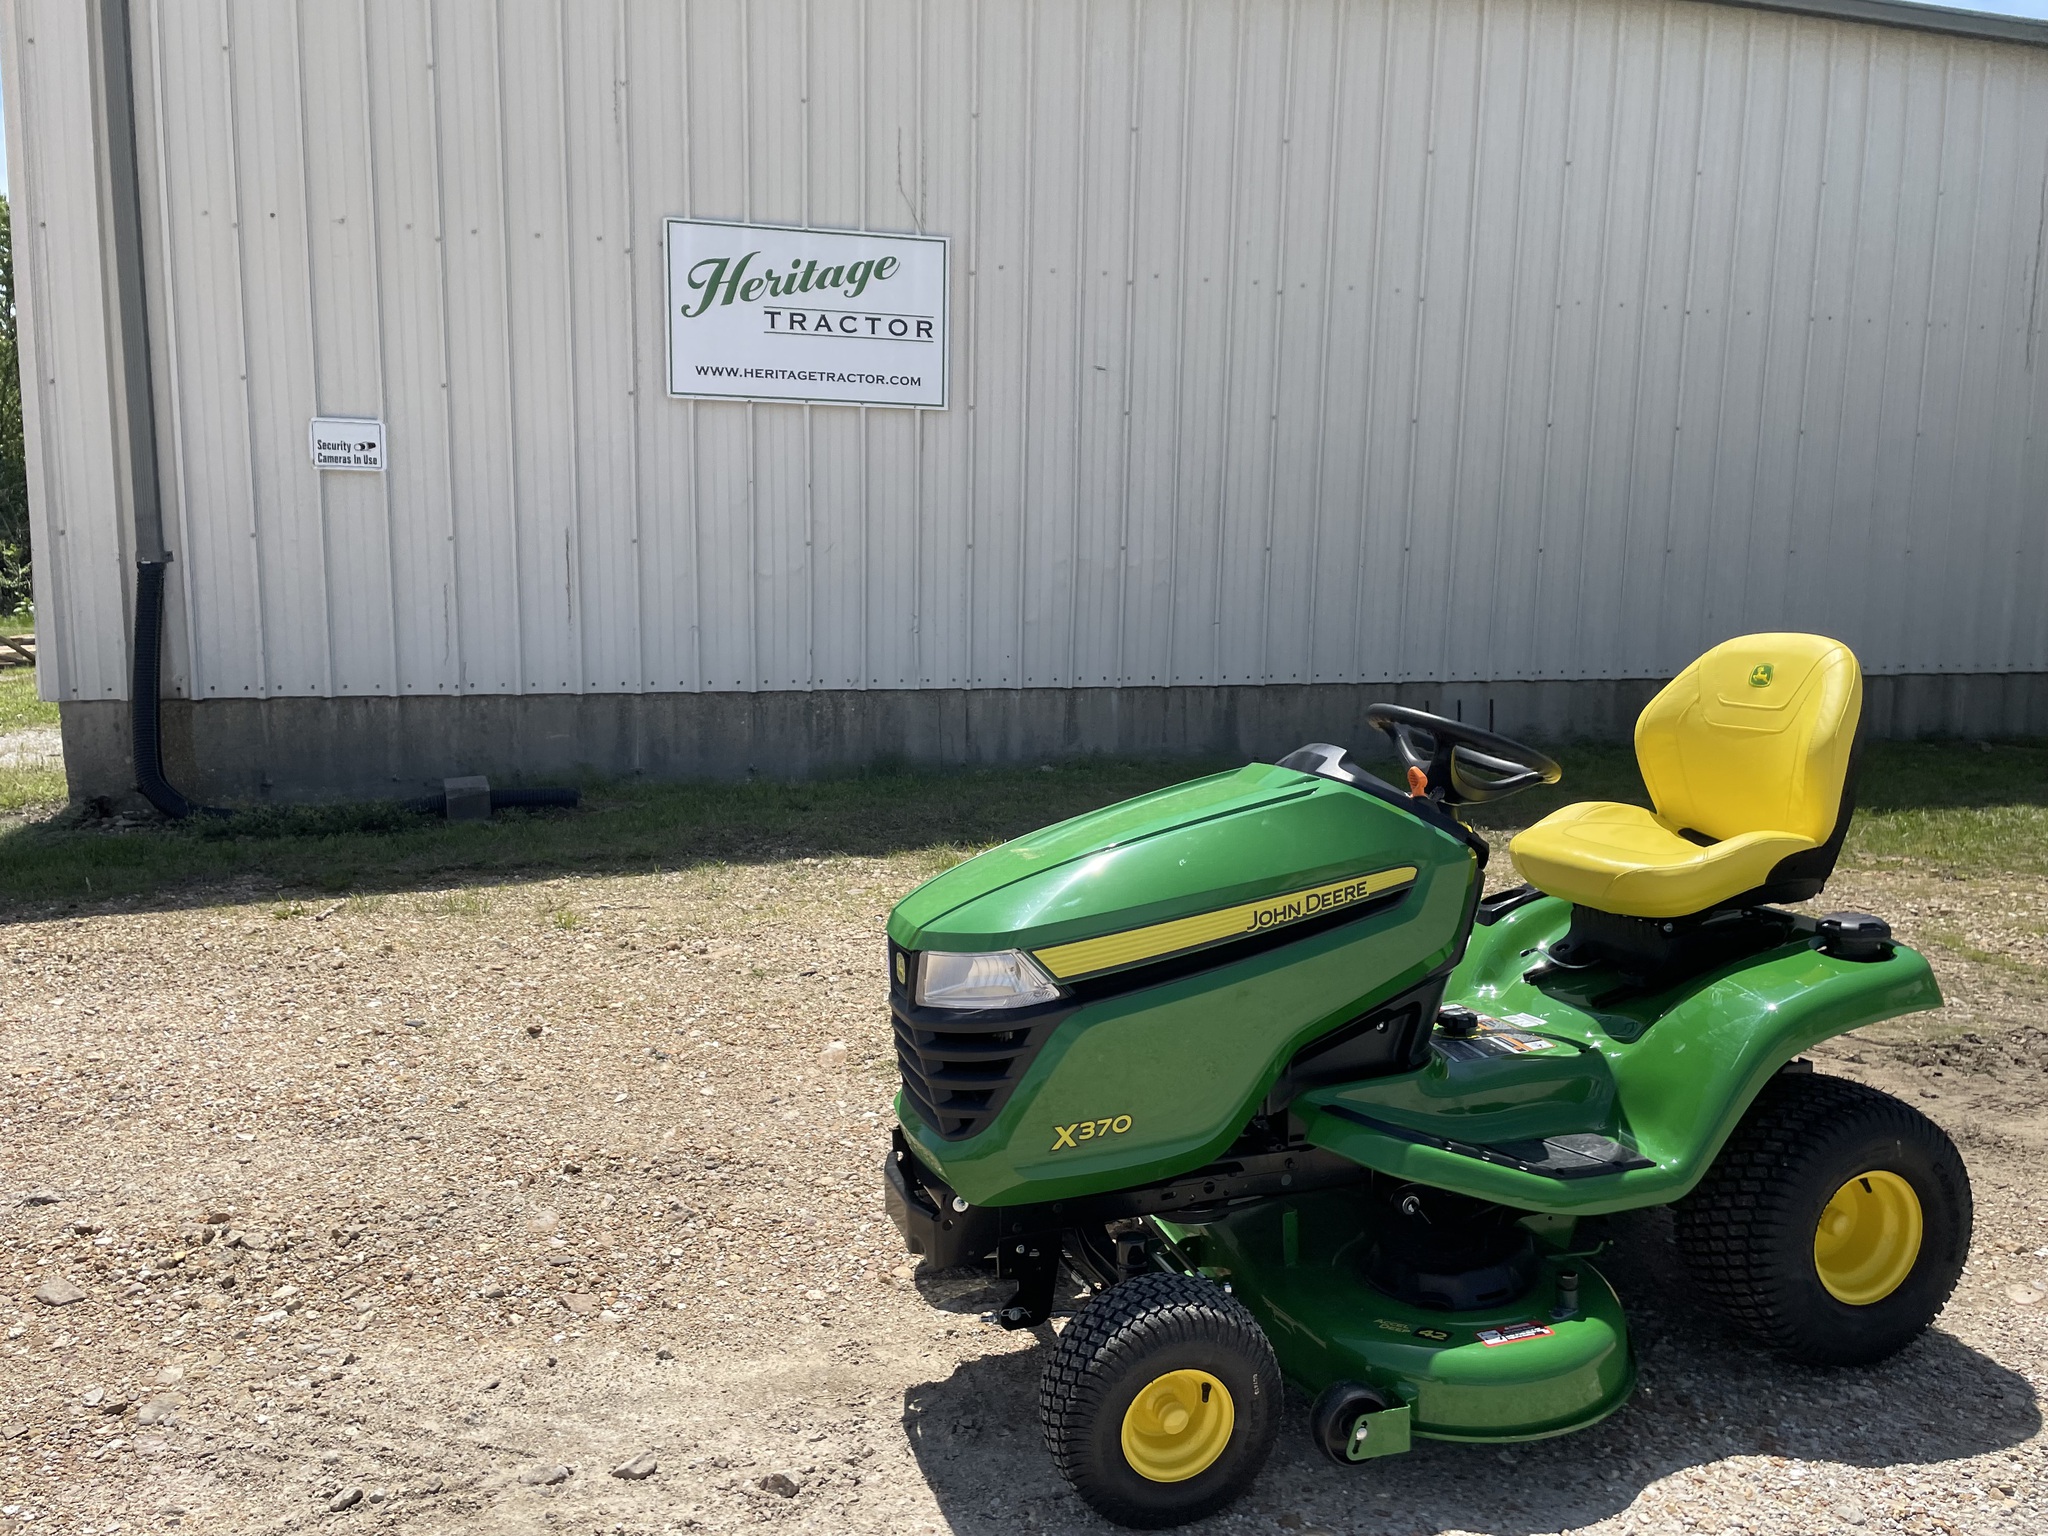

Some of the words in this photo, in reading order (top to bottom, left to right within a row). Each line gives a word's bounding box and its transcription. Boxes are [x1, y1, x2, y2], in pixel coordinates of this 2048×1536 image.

[680, 250, 901, 318] Heritage
[764, 310, 933, 339] TRACTOR
[695, 365, 922, 387] WWW.HERITAGETRACTOR.COM
[317, 440, 351, 453] Security
[317, 453, 351, 464] Cameras
[354, 454, 362, 464] In
[363, 454, 378, 465] Use
[1247, 901, 1301, 931] JOHN
[1306, 881, 1368, 913] DEERE
[1050, 1113, 1133, 1151] X370
[1417, 1329, 1448, 1341] 42
